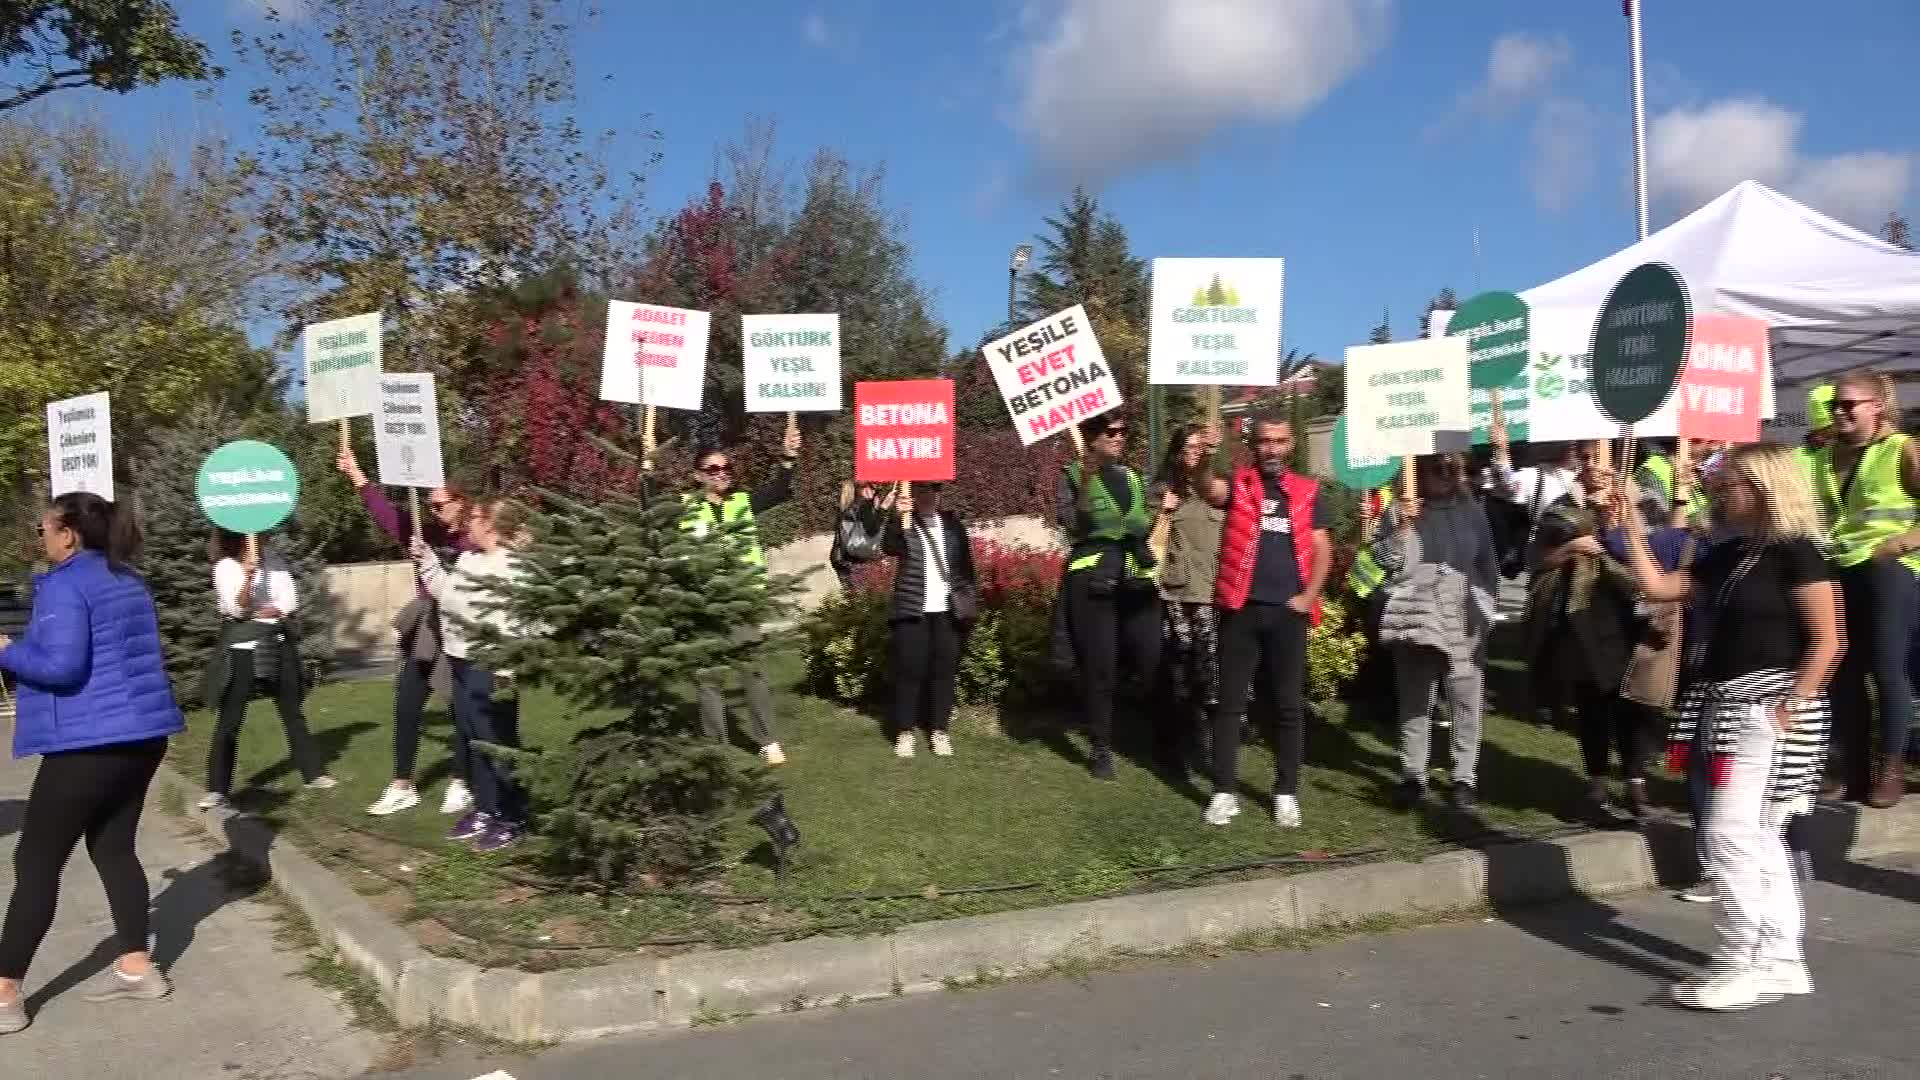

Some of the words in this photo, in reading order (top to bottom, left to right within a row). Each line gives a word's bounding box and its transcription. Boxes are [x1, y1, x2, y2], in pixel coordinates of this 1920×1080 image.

[633, 307, 687, 327] ADALET
[1172, 304, 1258, 325] GÖKTÜRK
[633, 329, 684, 348] HEMEN
[750, 329, 832, 349] GÖKTÜRK
[998, 316, 1078, 364] YEŞİLE
[1192, 333, 1238, 352] YEŞİL
[635, 350, 677, 369] ŞİMDİ
[1471, 340, 1529, 363] KUNMA
[311, 351, 374, 375] DOKUNMA!
[772, 355, 816, 377] YEŞİL
[1017, 344, 1076, 386] EVET
[1178, 359, 1248, 377] KALSIN!
[760, 383, 827, 400] KALSIN!
[1010, 361, 1108, 416] BETONA
[1685, 384, 1745, 416] YIR!
[860, 403, 949, 427] BETONA
[1028, 388, 1107, 436] HAYIR!
[868, 438, 943, 460] HAYIR!
[1261, 499, 1279, 515] LY
[1260, 516, 1291, 534] NSE
